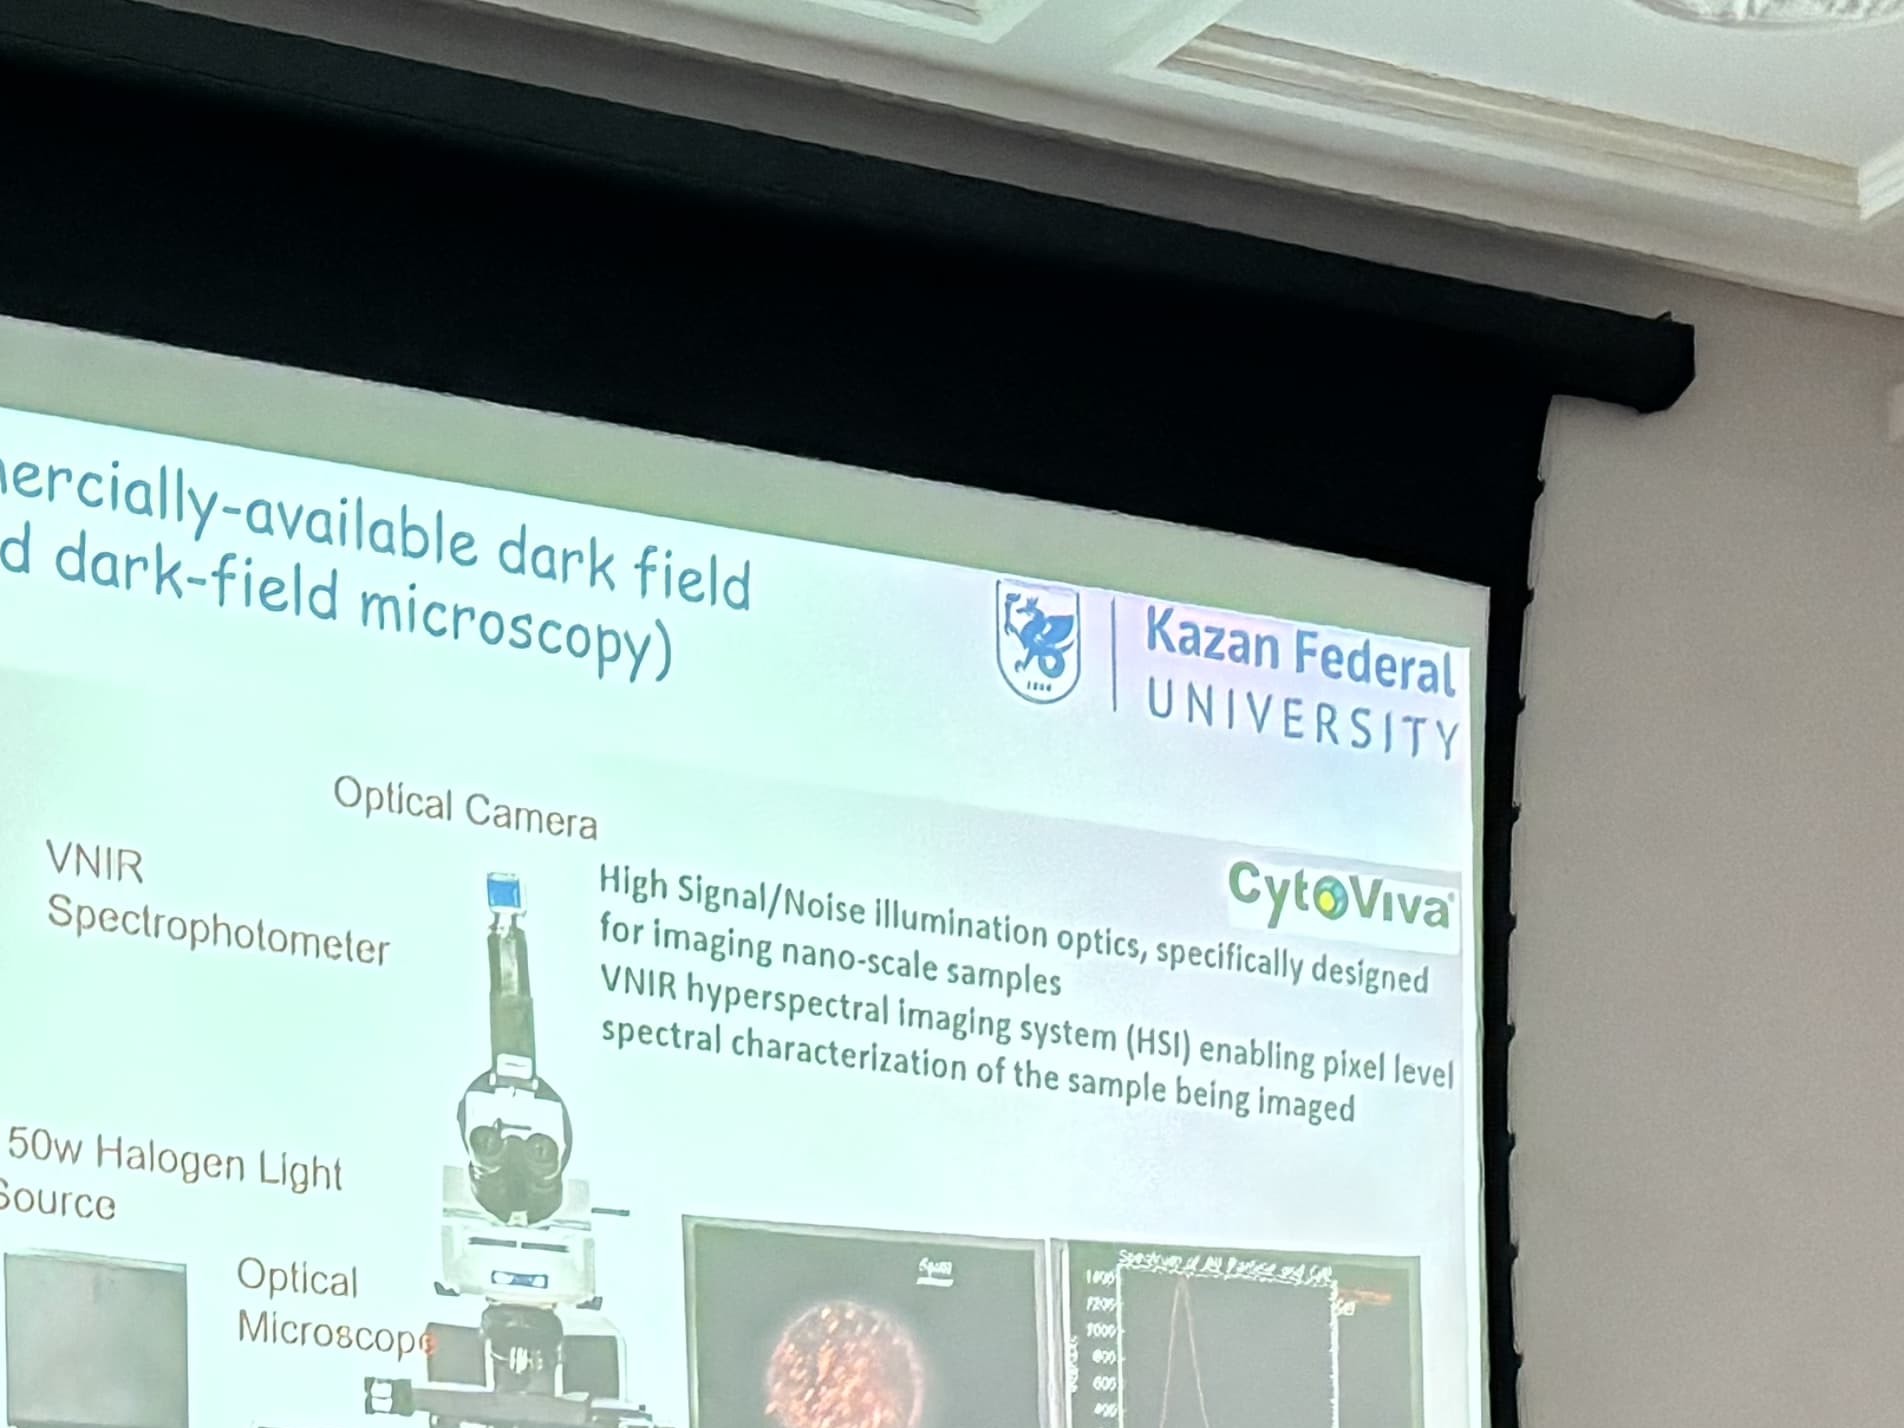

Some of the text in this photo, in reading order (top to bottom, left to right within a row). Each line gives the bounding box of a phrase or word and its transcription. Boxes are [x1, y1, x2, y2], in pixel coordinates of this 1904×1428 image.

[55, 530, 338, 621] dark-field
[360, 582, 673, 683] microscopy)
[498, 524, 615, 591] dark
[634, 546, 752, 611] field
[1147, 605, 1456, 697] Kazan Federal
[1149, 676, 1459, 761] UNIVERSITY
[334, 775, 599, 841] Optical Camera
[45, 838, 144, 883] VNIR
[48, 893, 390, 966] Spectrophotometer
[600, 863, 1430, 995] High Signal/Noise illumination optics, specifically designed
[600, 910, 1062, 998] for imaging nano-scale samples
[600, 963, 1455, 1090] VNIR hyperspectral imaging system (HSI) enabling pixel level
[602, 1018, 1356, 1126] spectral characterization of the sample being imaged
[96, 1134, 244, 1184] Halogen
[260, 1150, 343, 1194] Light
[238, 1257, 357, 1299] Optical
[238, 1309, 436, 1362] Microscope
